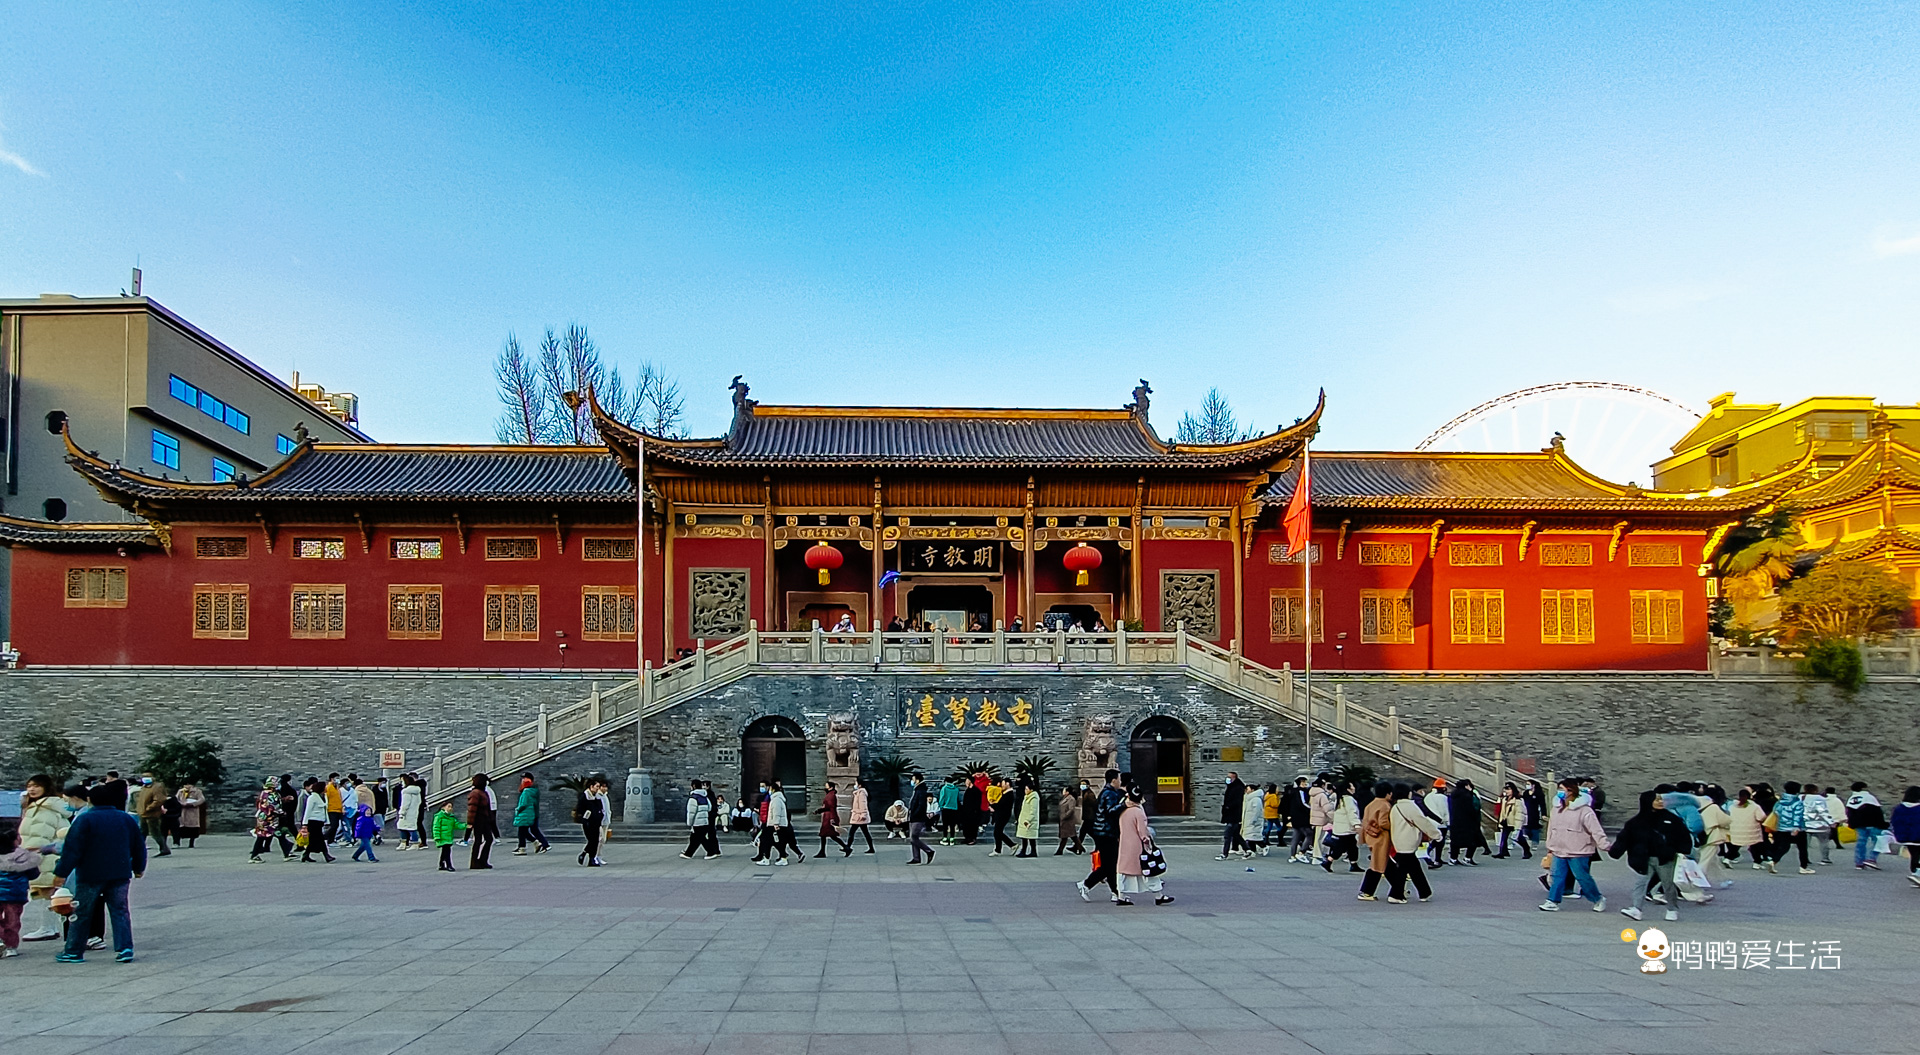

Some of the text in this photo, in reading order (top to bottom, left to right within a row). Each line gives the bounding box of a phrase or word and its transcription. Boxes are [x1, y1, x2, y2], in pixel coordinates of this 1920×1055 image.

[921, 546, 993, 568] 明教寺
[384, 752, 401, 760] 出口
